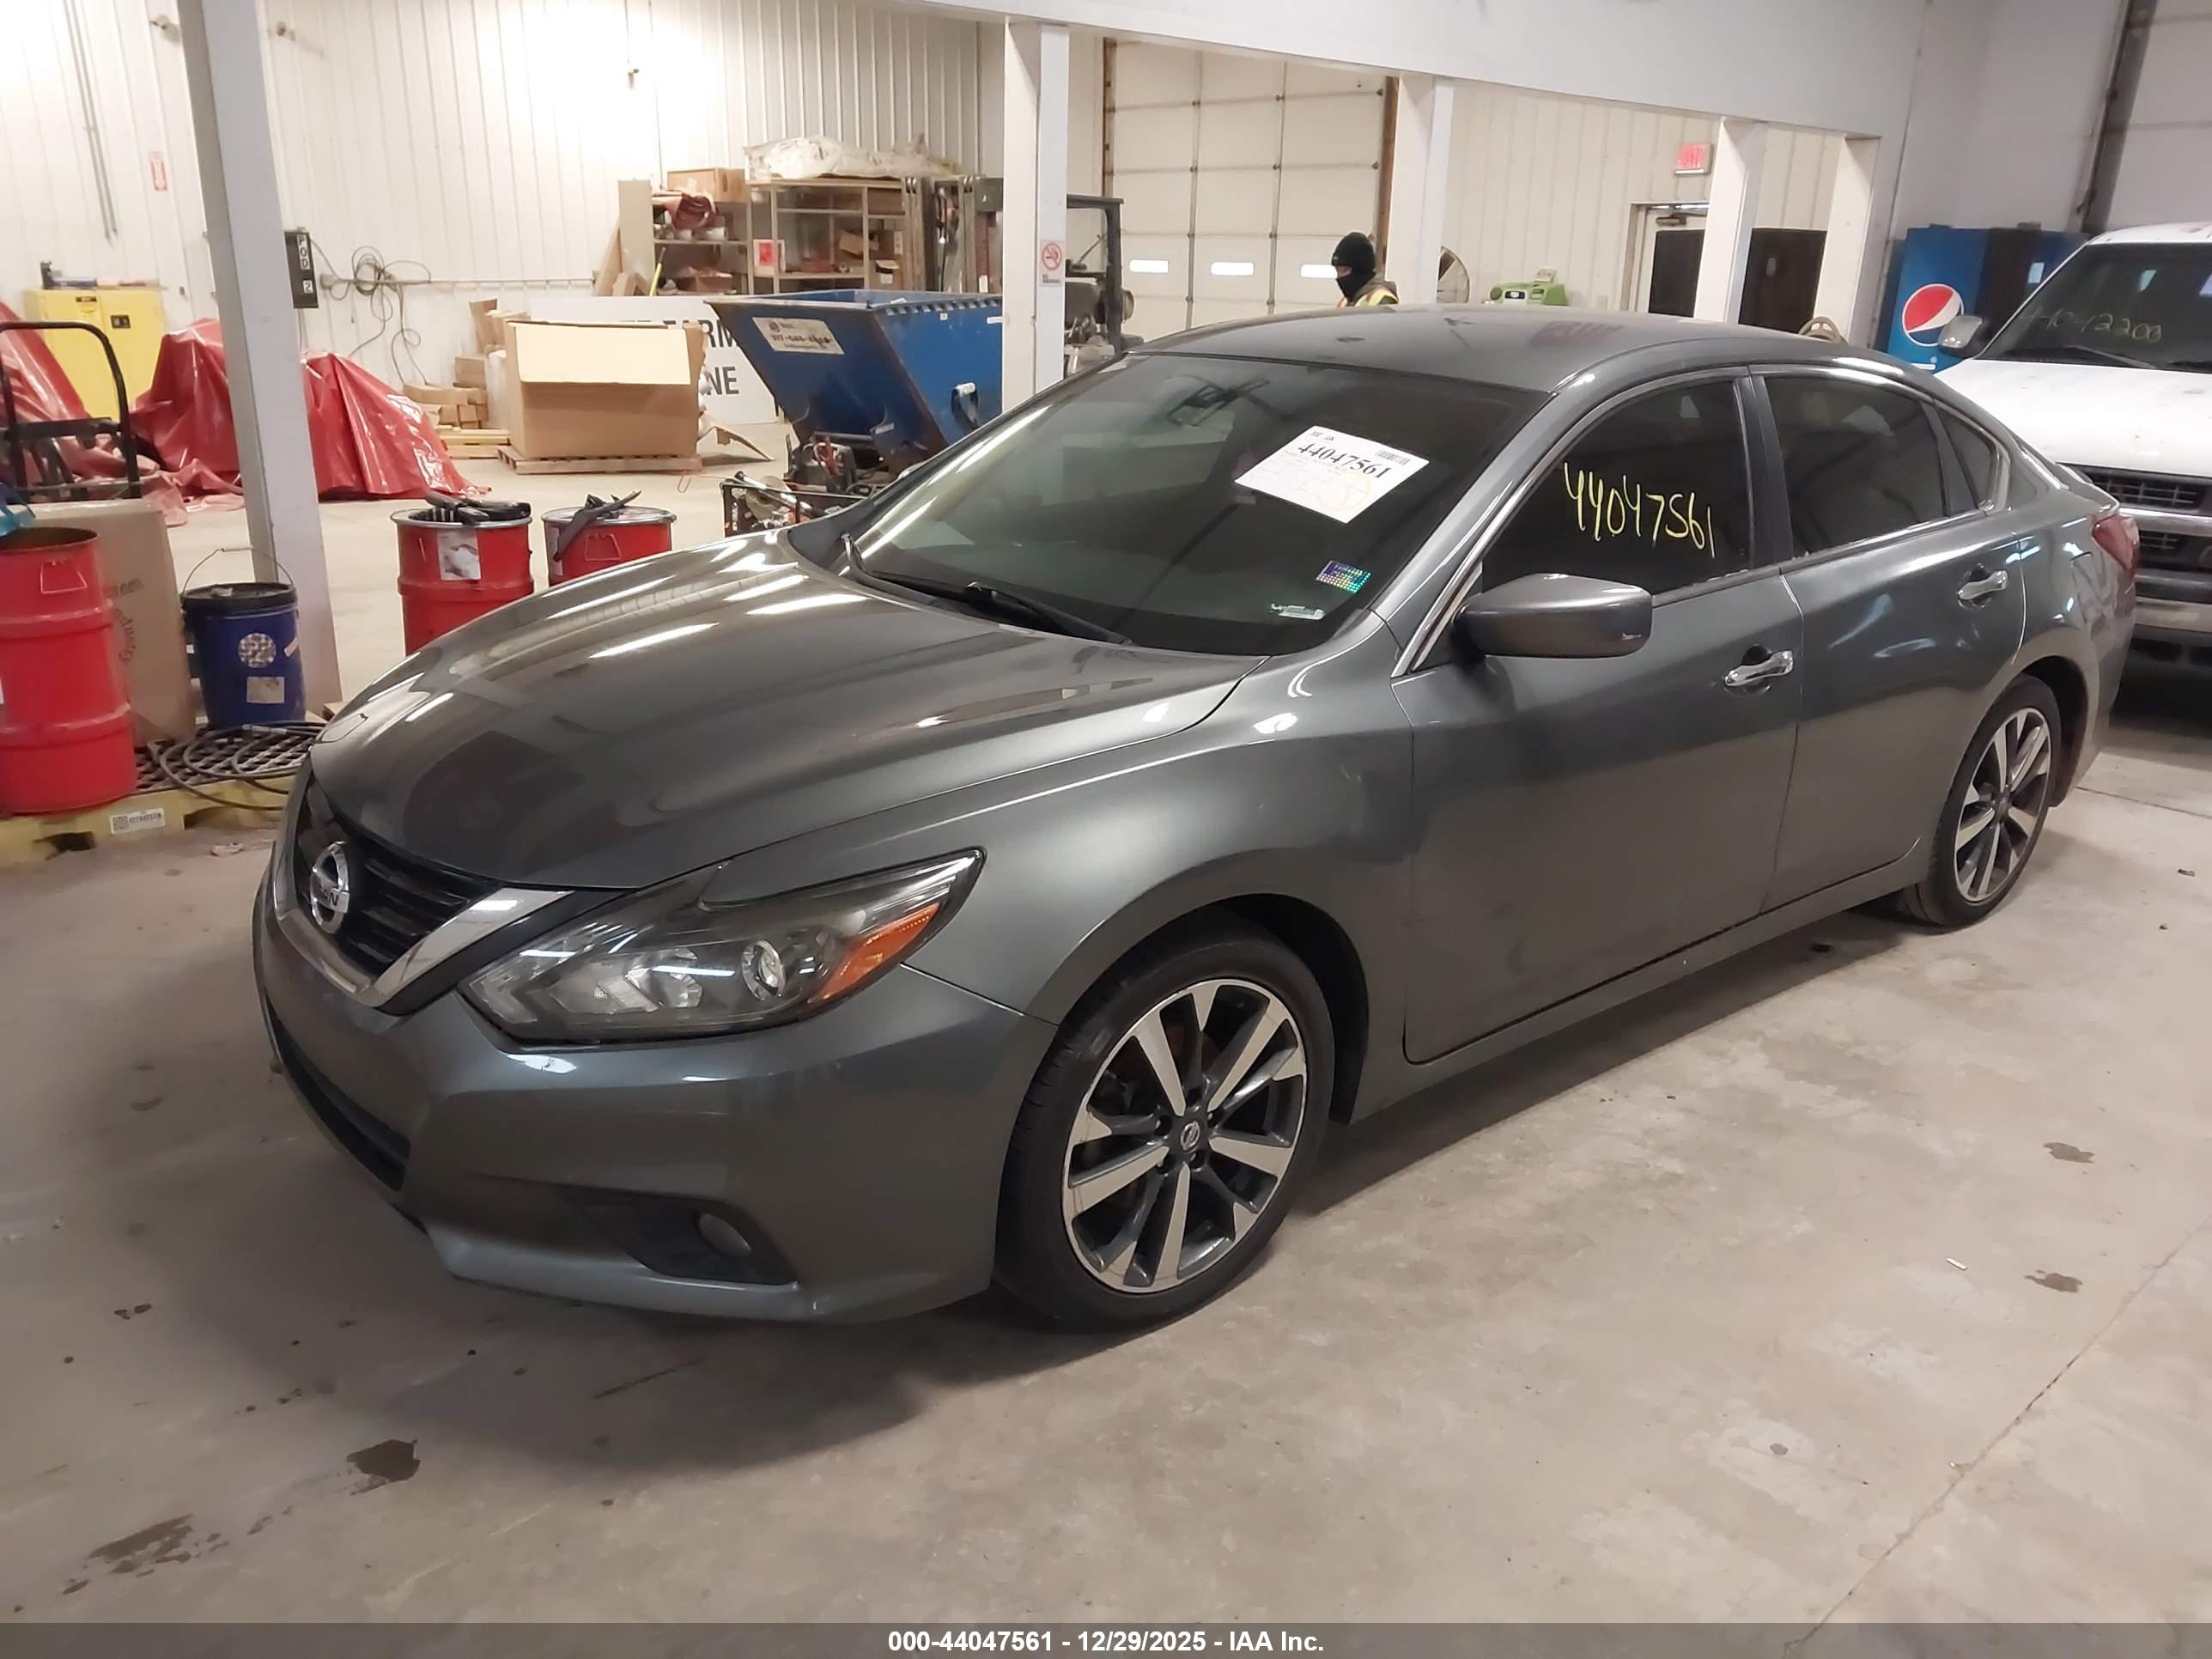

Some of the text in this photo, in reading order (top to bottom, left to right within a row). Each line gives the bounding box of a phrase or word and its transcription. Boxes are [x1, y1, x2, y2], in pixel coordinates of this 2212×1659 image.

[297, 234, 312, 292] POD 2
[1297, 442, 1392, 479] 44047561
[1564, 462, 1715, 559] 44047561
